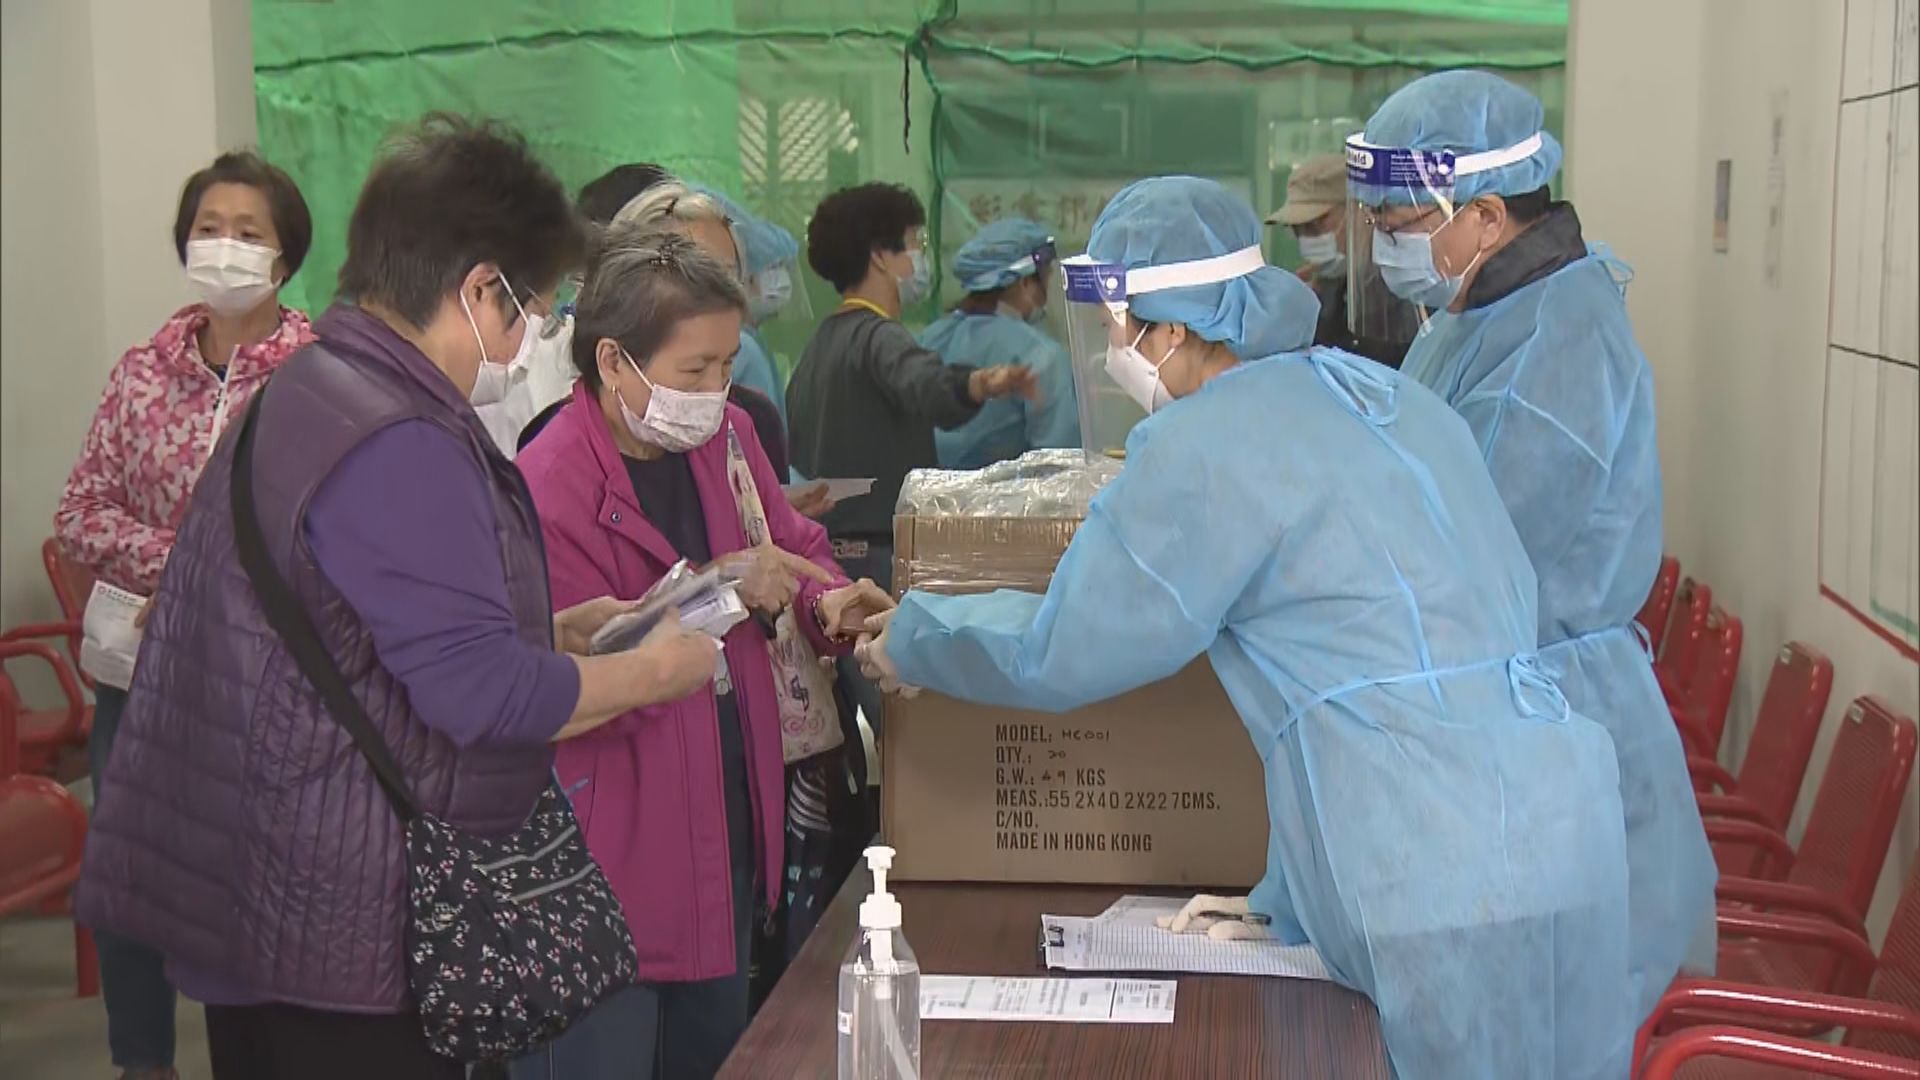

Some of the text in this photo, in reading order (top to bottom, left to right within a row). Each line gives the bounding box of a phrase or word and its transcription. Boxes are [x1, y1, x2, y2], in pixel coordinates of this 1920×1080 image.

[995, 724, 1053, 743] MODEL:
[995, 767, 1035, 786] G.W.:
[1076, 768, 1106, 786] KGS
[995, 810, 1039, 829] C/NO.
[996, 831, 1152, 852] MADE IN HONG KONG
